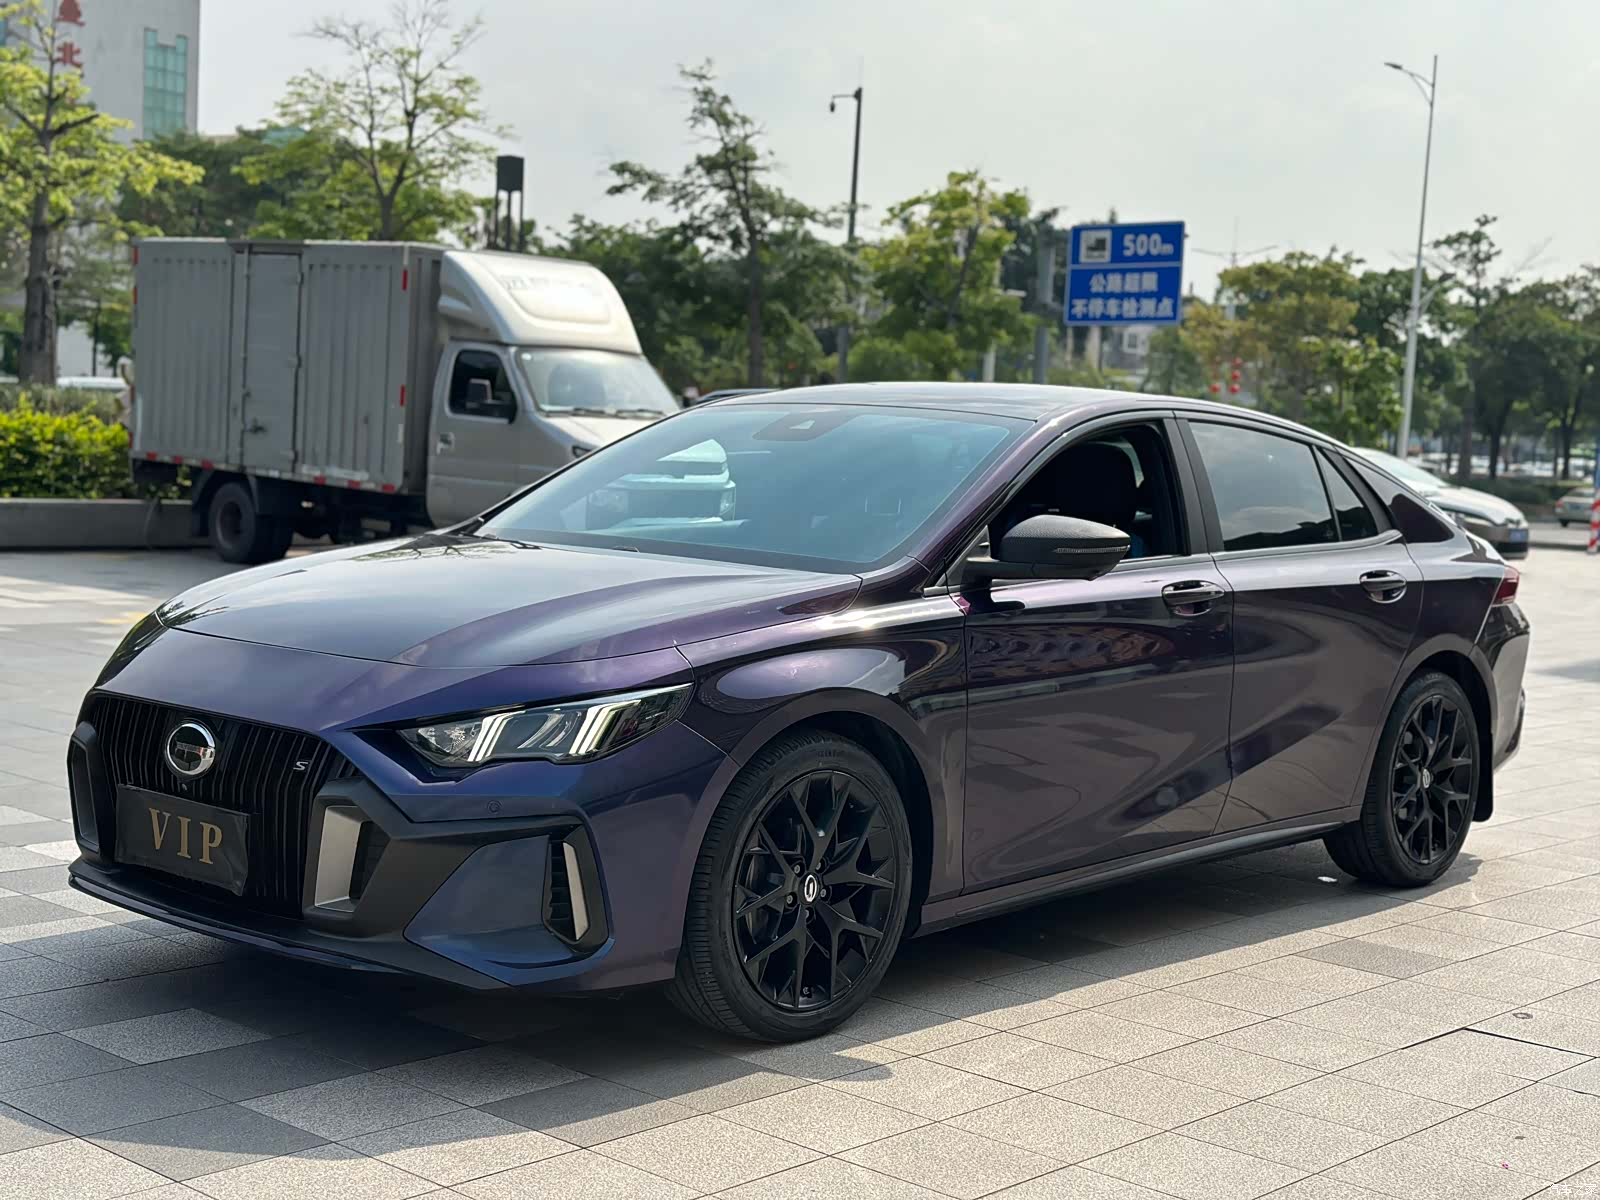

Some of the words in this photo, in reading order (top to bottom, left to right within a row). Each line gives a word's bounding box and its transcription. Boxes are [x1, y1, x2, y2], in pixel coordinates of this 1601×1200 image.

[1122, 233, 1174, 257] 500m
[1071, 295, 1174, 319] 不停车检测点
[292, 761, 309, 771] S
[148, 807, 223, 865] VIP
